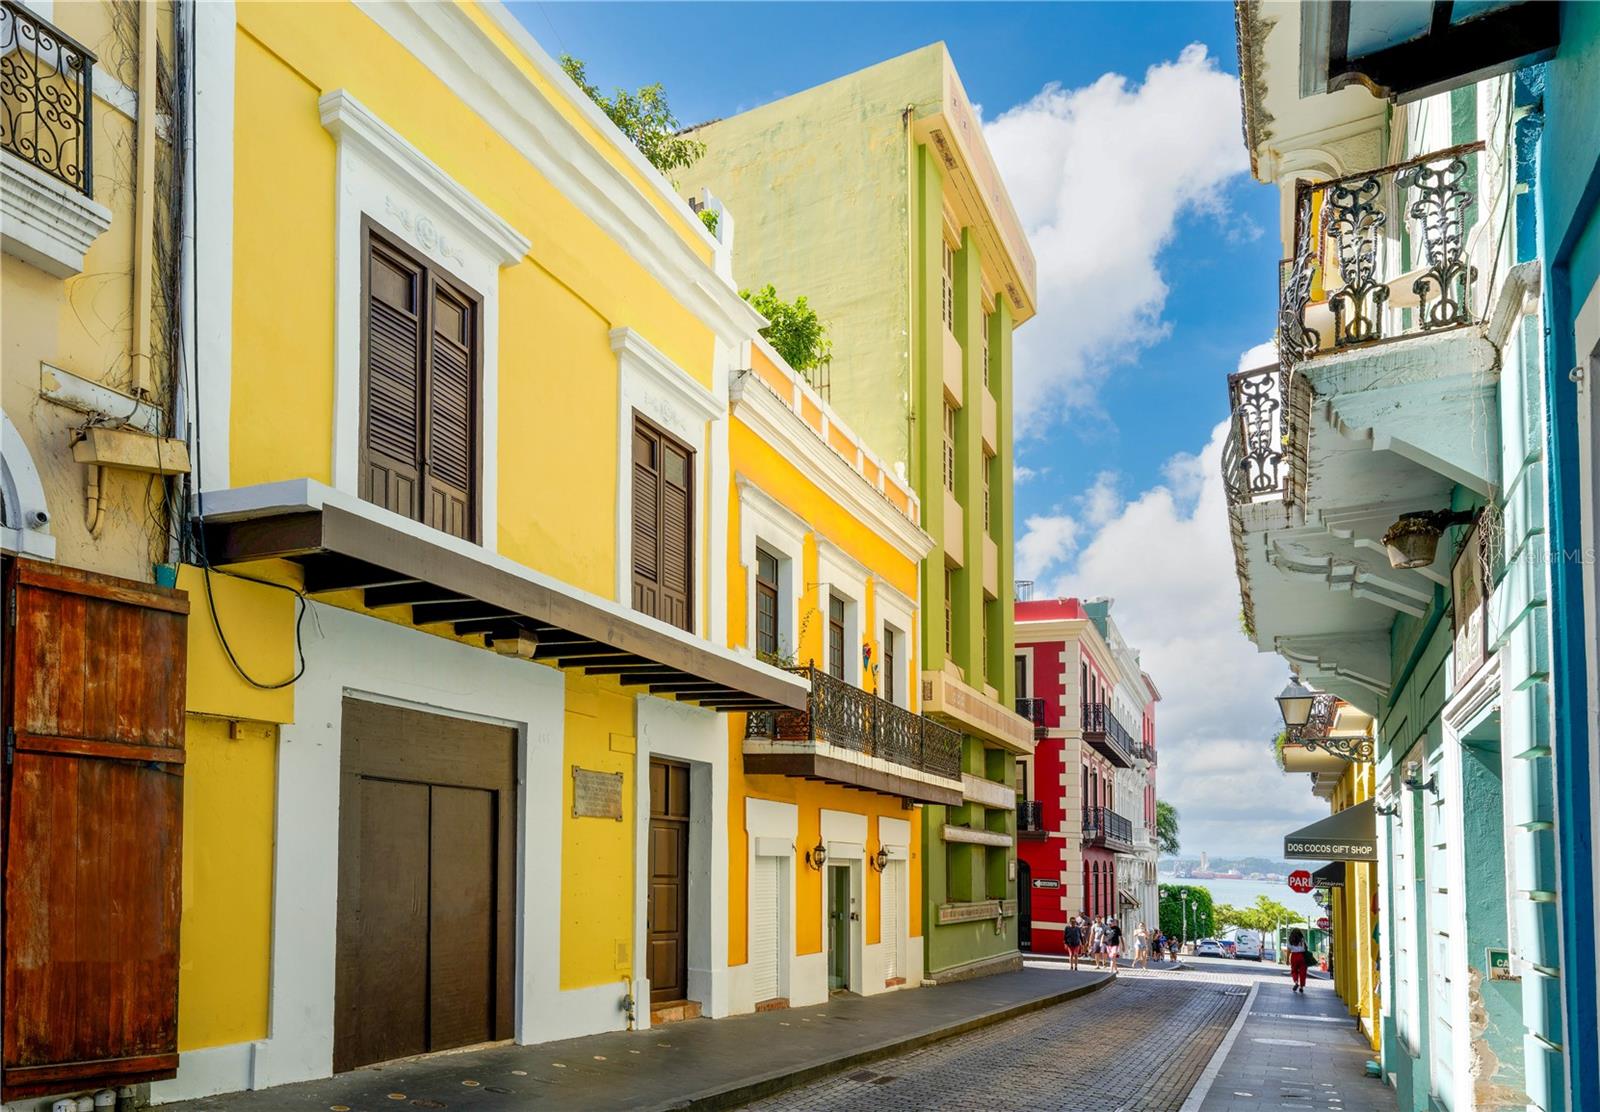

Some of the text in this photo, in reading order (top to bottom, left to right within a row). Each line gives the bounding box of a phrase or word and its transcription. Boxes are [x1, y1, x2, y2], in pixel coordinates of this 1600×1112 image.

[1288, 843, 1372, 854] DOS COCOS GIFT SHOP
